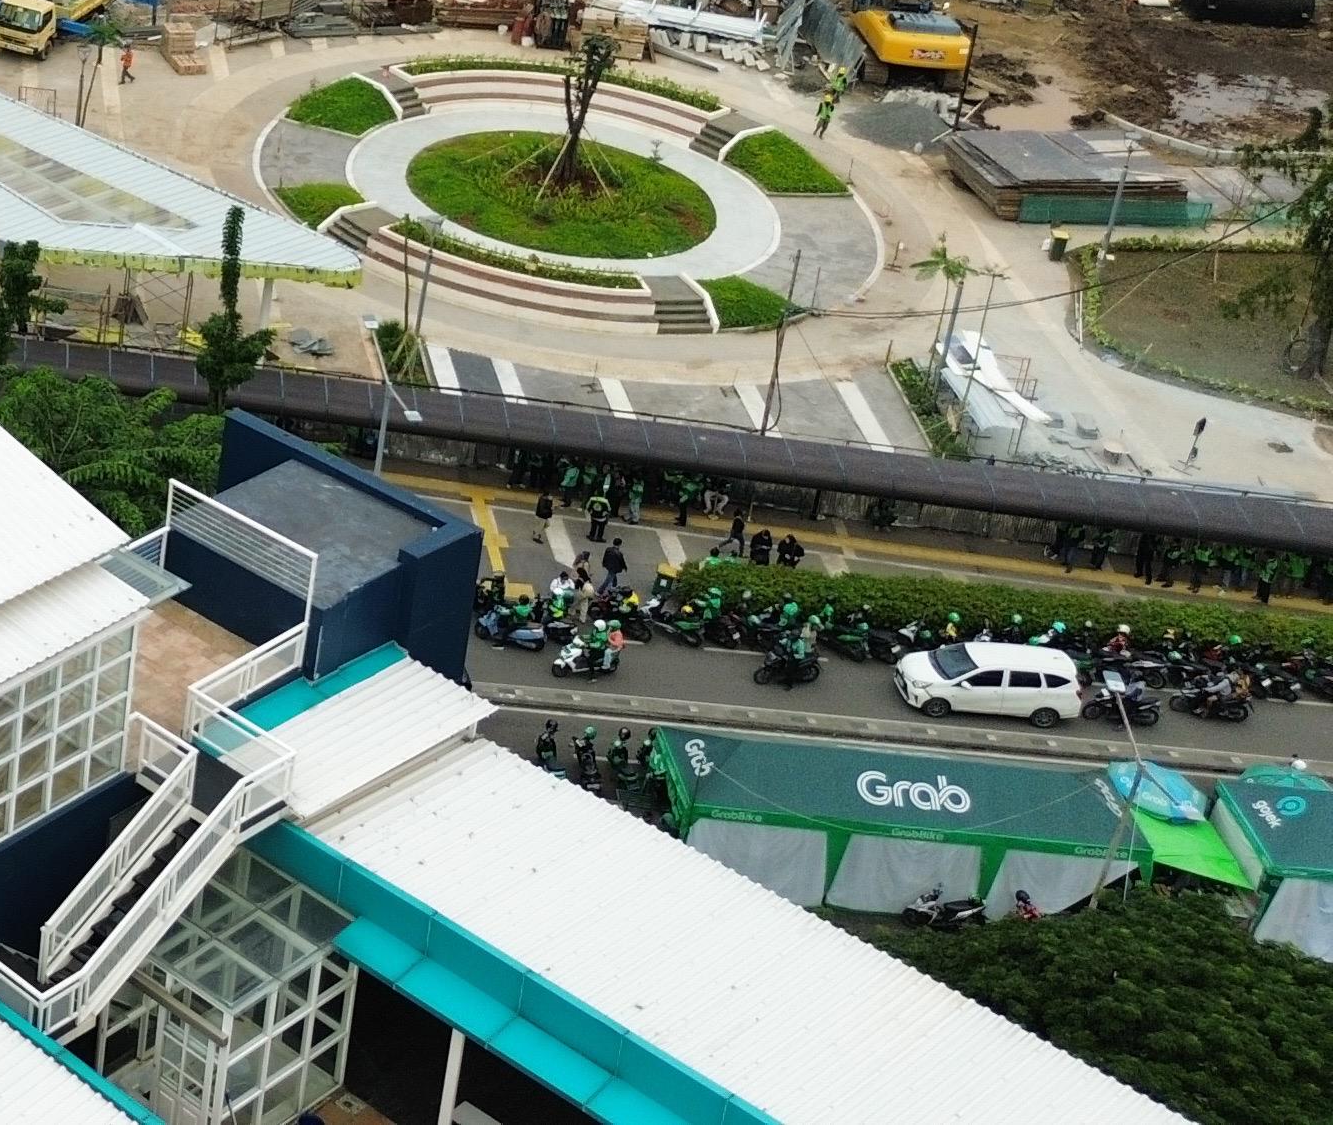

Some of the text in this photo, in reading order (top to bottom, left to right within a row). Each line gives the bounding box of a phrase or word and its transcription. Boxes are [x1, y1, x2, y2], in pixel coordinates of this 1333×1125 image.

[684, 738, 715, 777] Grab
[856, 770, 971, 814] Grab
[1251, 799, 1282, 829] gojek
